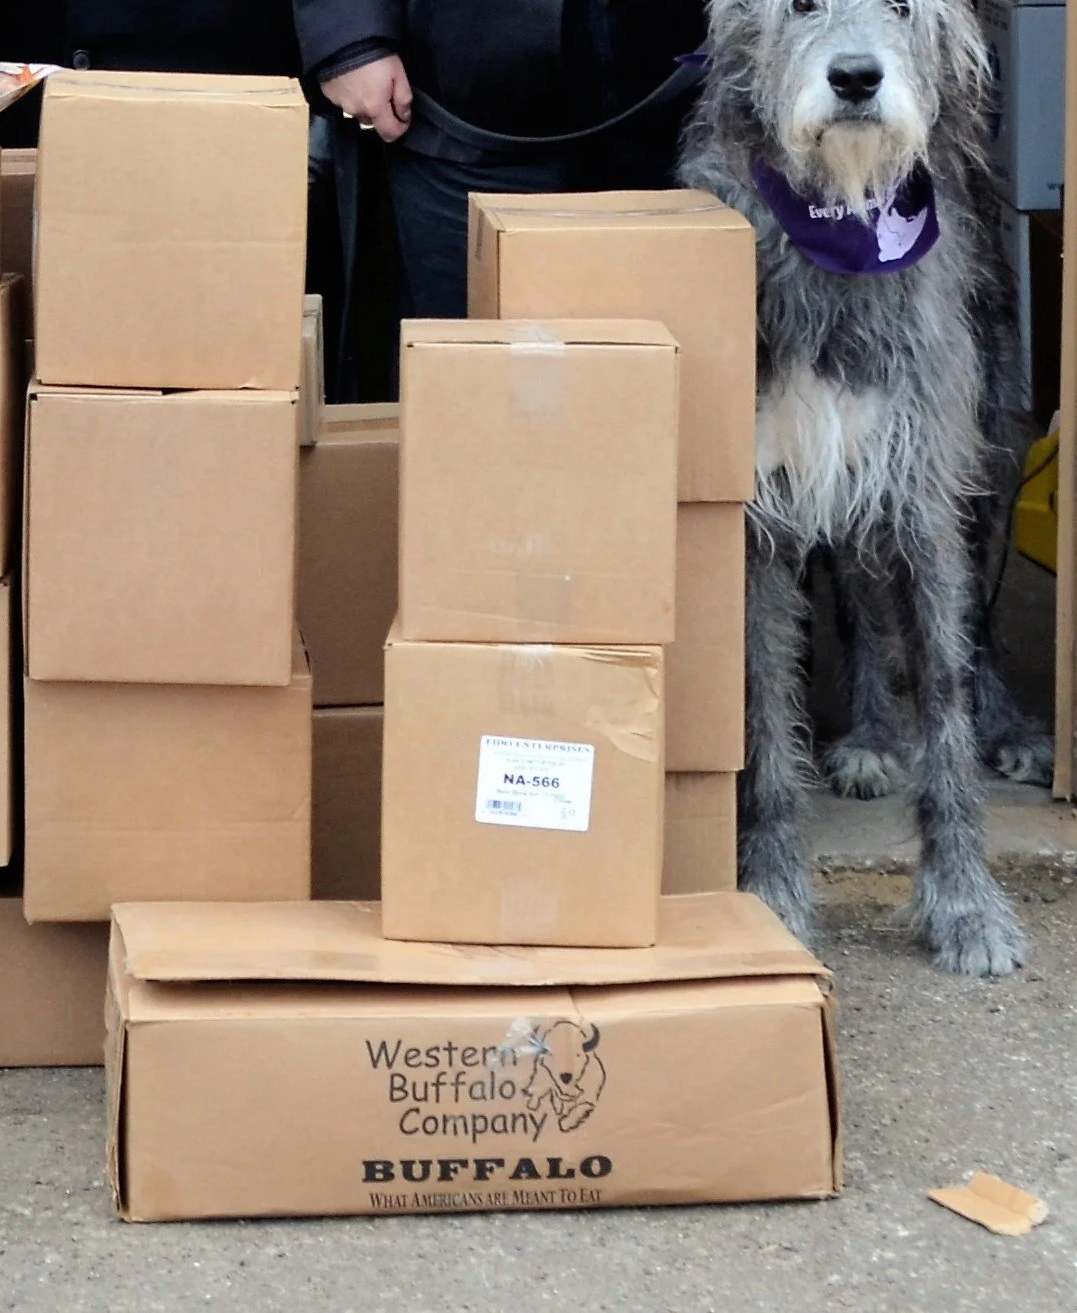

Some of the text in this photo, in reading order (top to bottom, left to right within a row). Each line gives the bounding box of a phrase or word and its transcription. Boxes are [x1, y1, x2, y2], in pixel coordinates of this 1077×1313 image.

[503, 773, 560, 789] NA-566
[365, 1039, 519, 1069] Western
[389, 1070, 517, 1104] Buffalo
[399, 1108, 548, 1144] Company
[362, 1155, 613, 1183] BUFFALO
